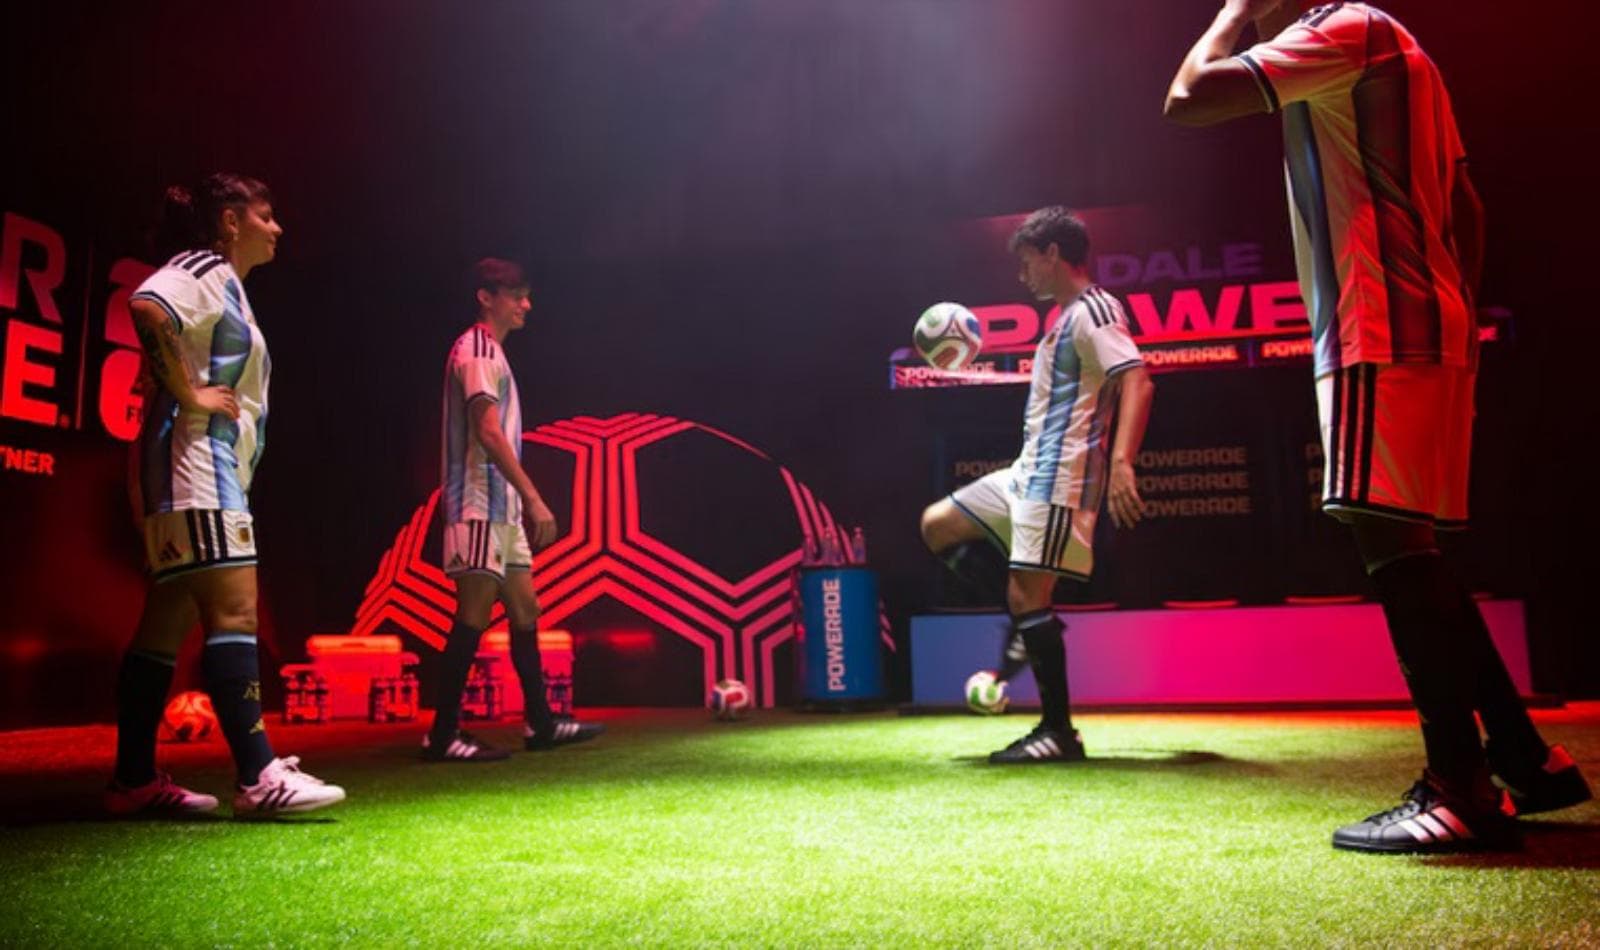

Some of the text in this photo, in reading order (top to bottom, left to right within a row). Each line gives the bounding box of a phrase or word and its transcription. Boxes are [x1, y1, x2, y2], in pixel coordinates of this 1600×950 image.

[1096, 243, 1263, 287] DALE
[969, 281, 1313, 350] PWE
[1144, 496, 1251, 518] OWERADE
[822, 578, 847, 691] POWERADE
